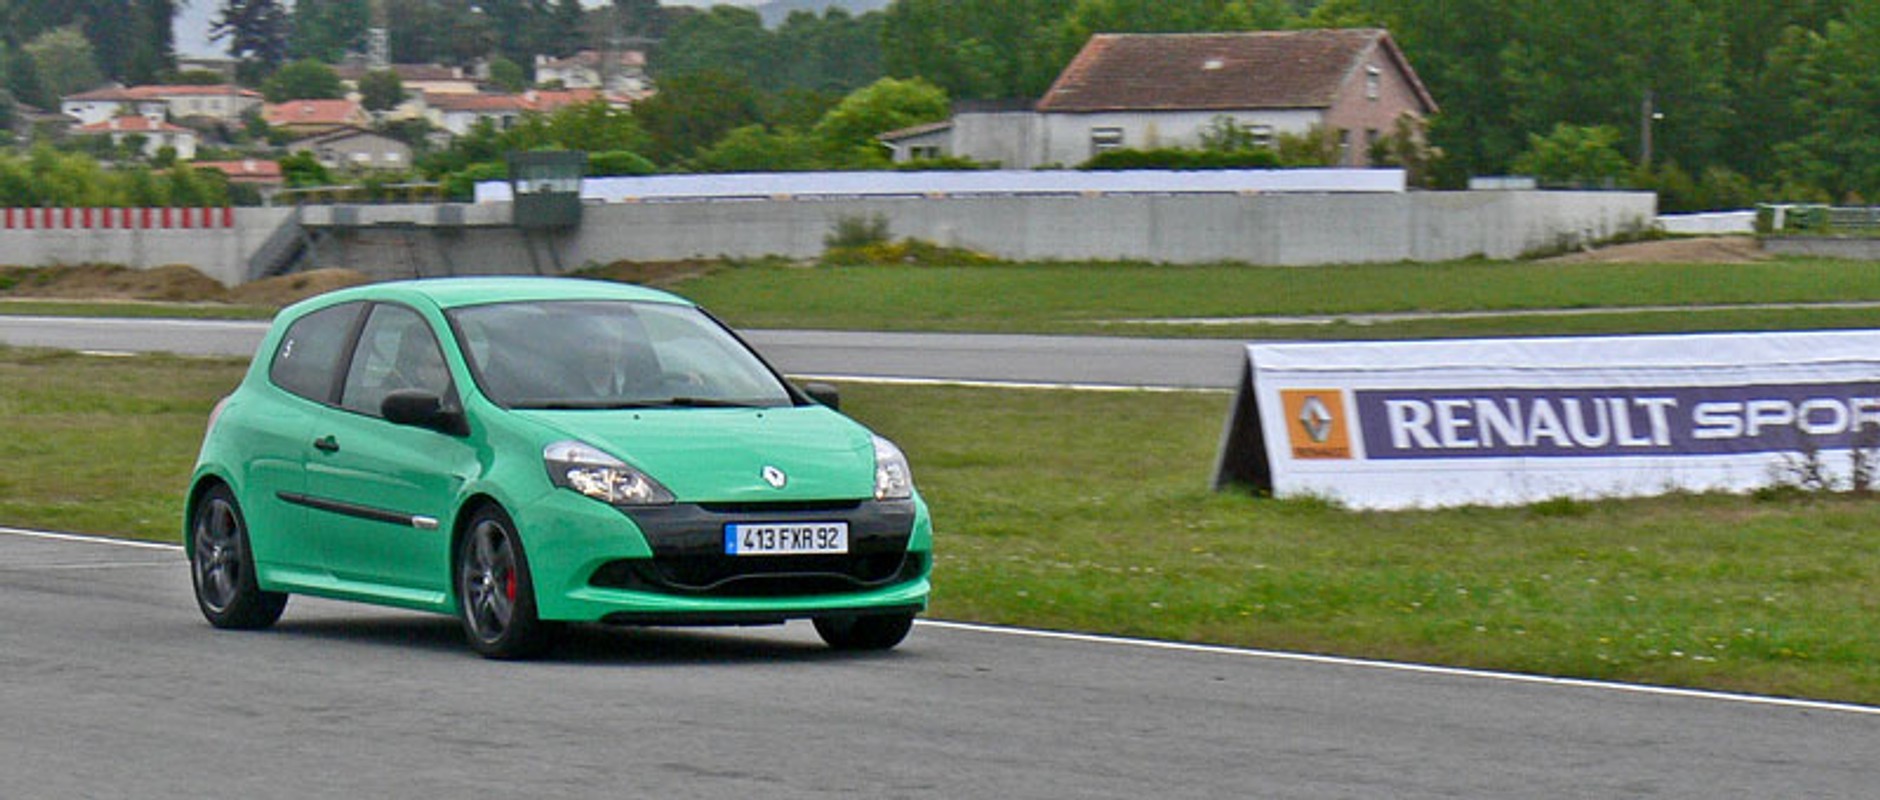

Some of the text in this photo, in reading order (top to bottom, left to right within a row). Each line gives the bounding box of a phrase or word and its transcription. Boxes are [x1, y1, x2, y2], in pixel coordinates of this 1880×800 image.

[1384, 397, 1678, 449] RENAULT
[743, 527, 840, 550] 413 FXR 92
